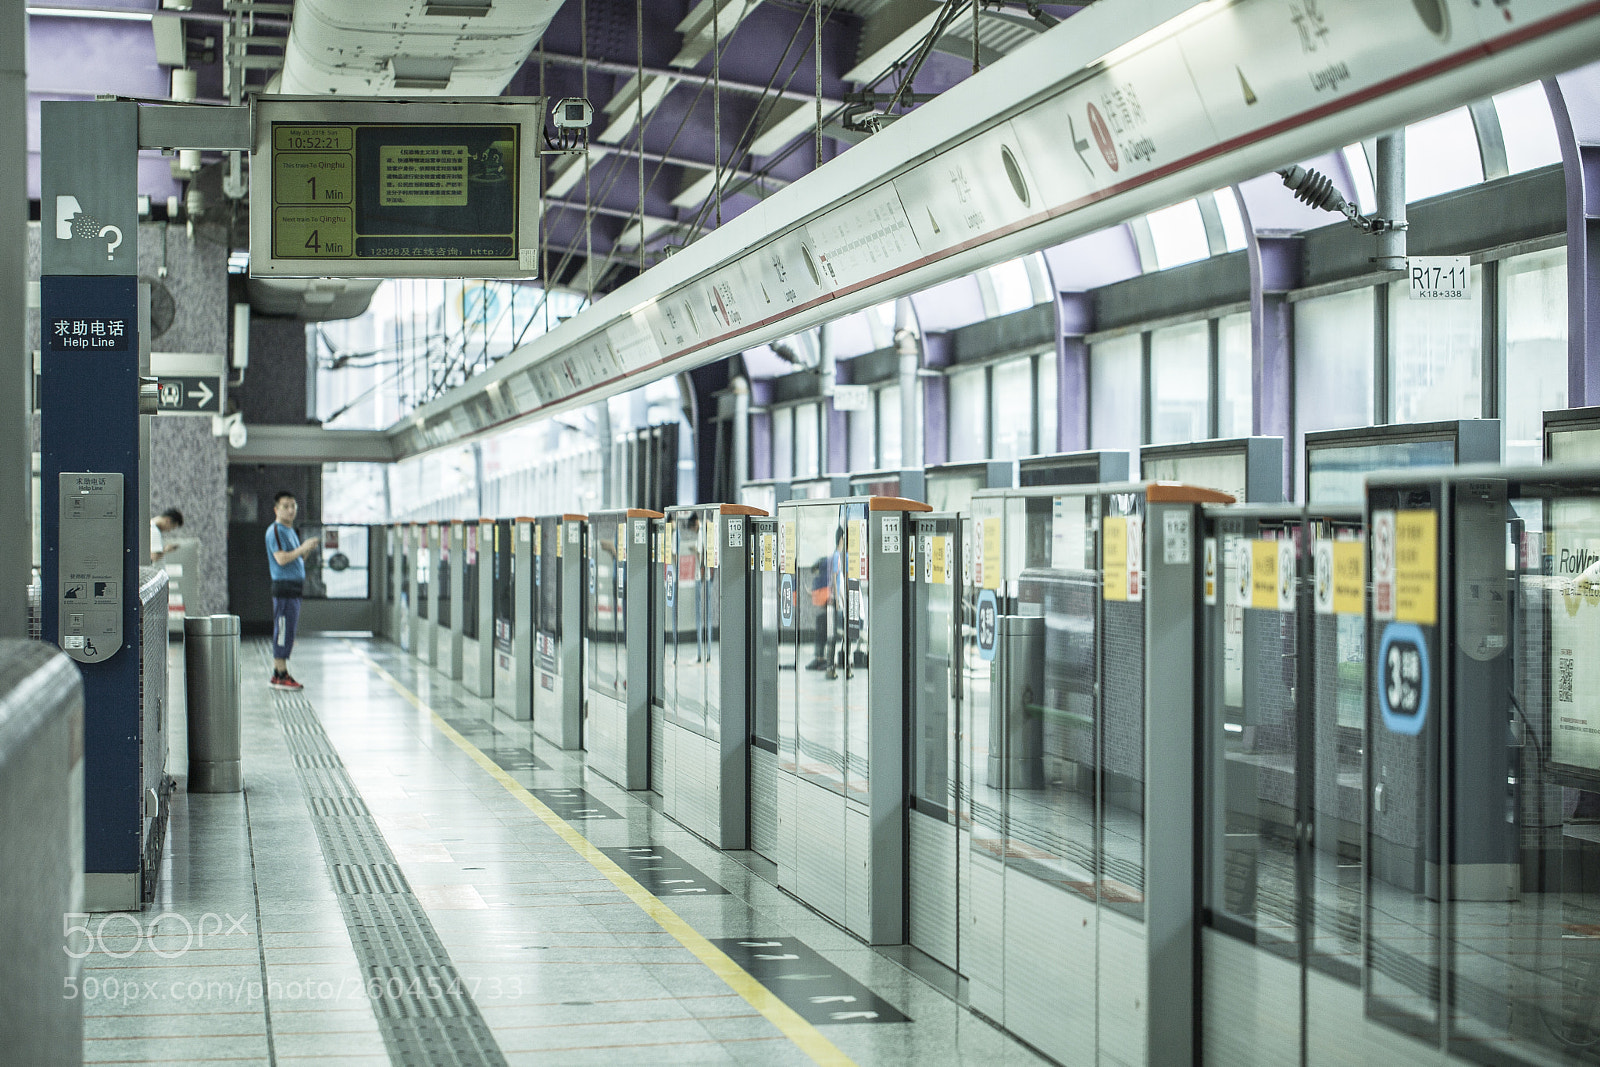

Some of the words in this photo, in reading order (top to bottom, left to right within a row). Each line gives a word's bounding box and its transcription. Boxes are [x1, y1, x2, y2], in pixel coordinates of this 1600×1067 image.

[288, 137, 339, 149] 10:52:21
[318, 161, 345, 171] Qinghu
[307, 176, 316, 200] 1
[325, 189, 344, 200] Min
[319, 215, 346, 225] Qinghu
[304, 229, 322, 254] 4
[325, 242, 344, 253] Min
[1412, 266, 1467, 290] R17-11
[1419, 290, 1462, 298] K18+338
[54, 320, 124, 336] 求助电话
[63, 337, 88, 349] Help
[91, 337, 115, 347] Line
[729, 523, 742, 531] 110
[885, 523, 899, 532] 111
[893, 535, 899, 543] 3
[893, 544, 899, 552] 9
